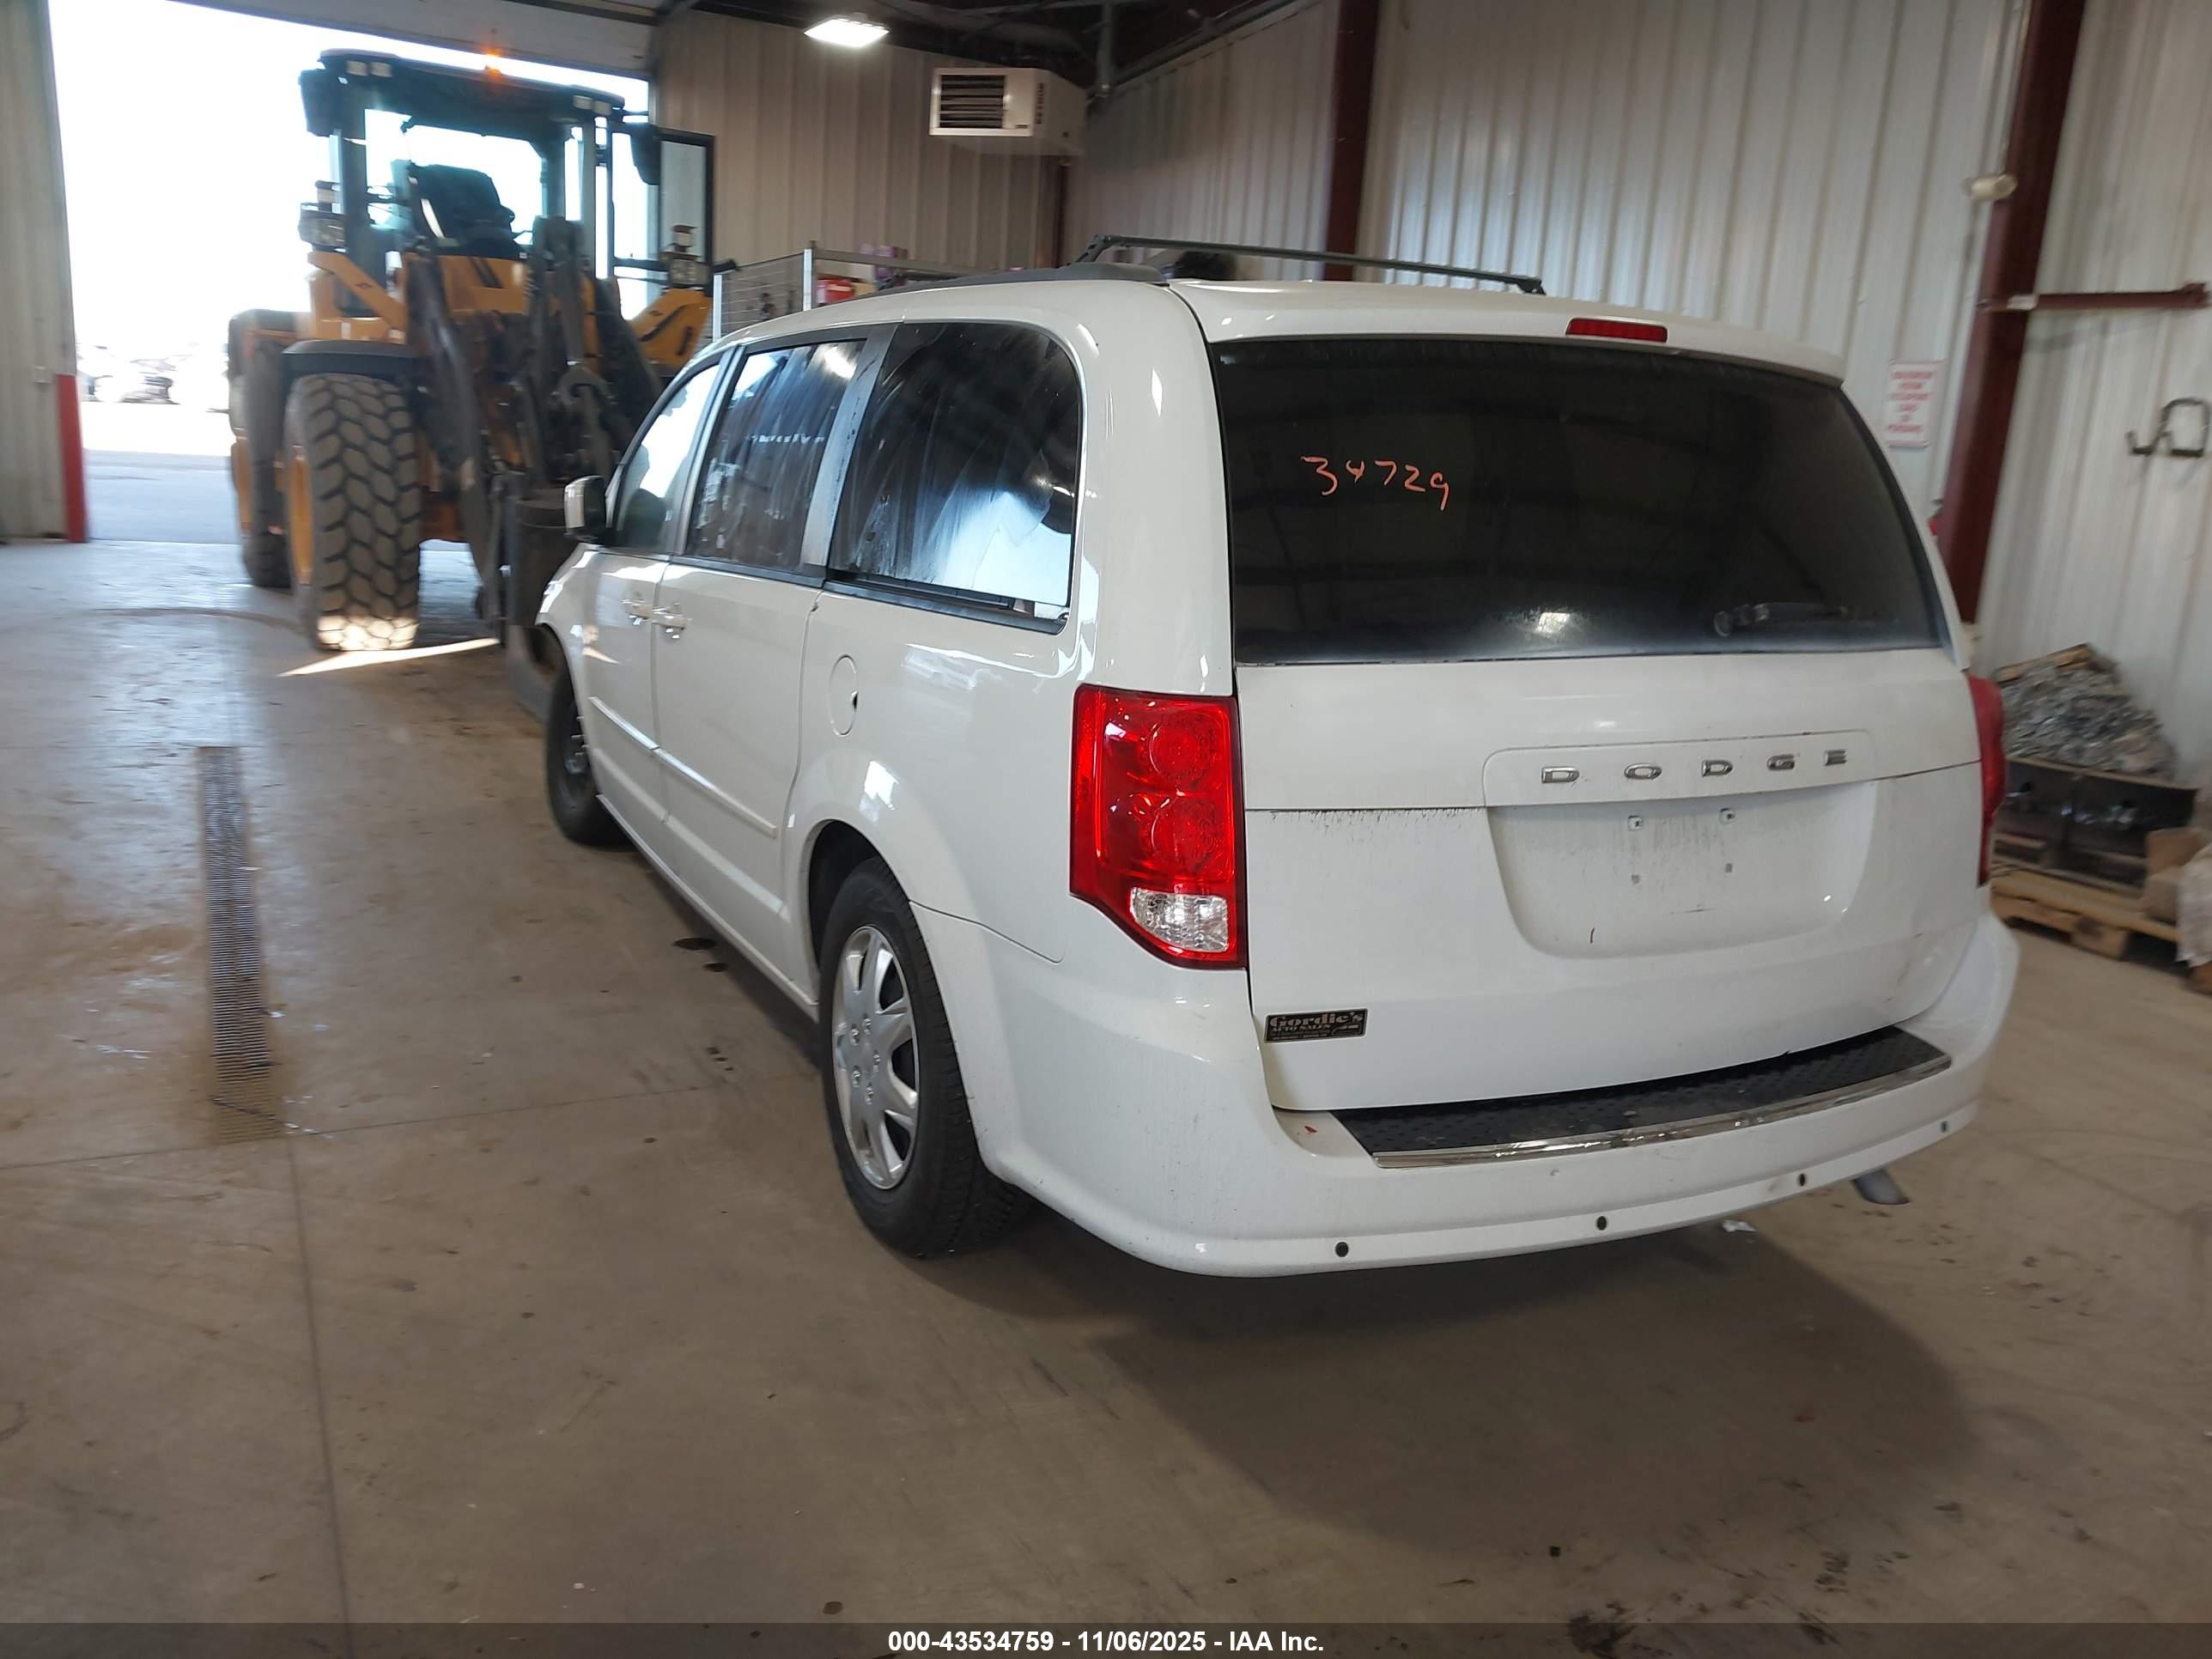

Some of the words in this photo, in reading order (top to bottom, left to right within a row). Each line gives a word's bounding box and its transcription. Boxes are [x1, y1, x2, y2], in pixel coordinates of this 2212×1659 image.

[1300, 456, 1449, 511] 34729
[1540, 749, 1847, 784] DODGE
[1270, 1012, 1364, 1027] Gordie's
